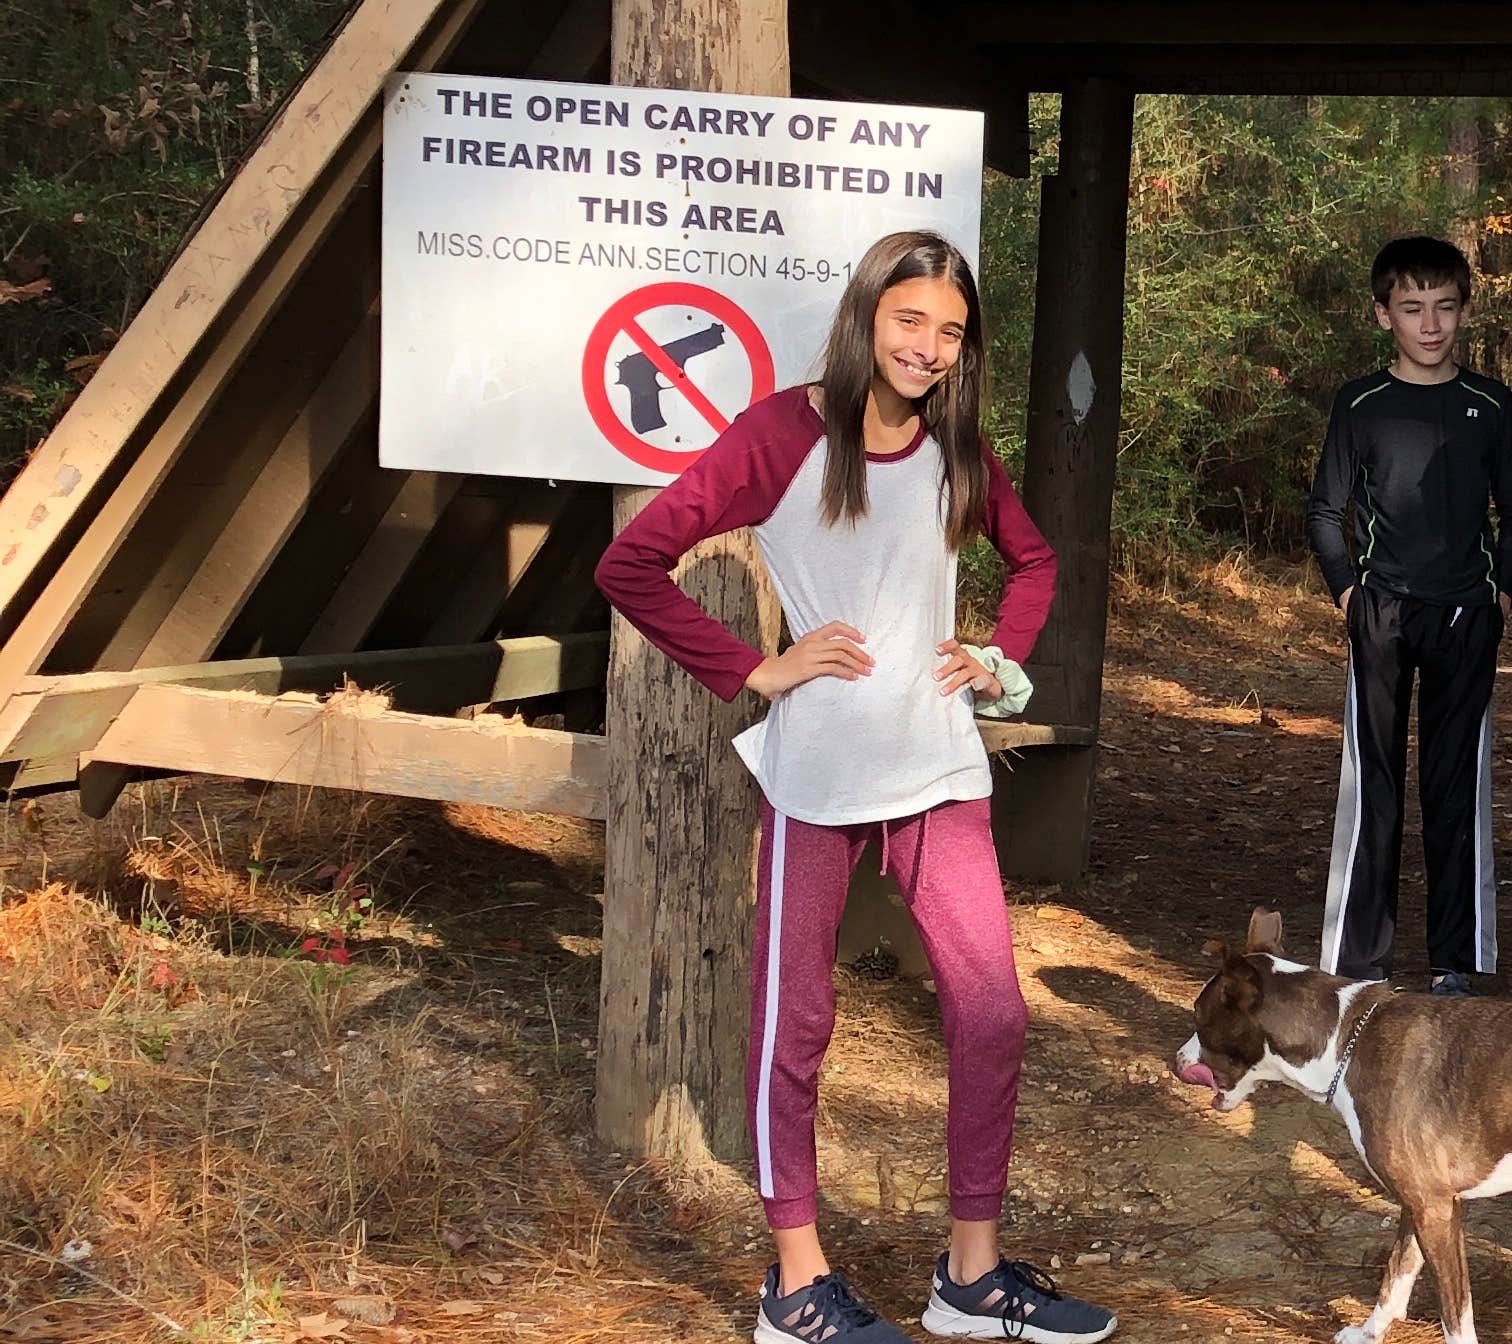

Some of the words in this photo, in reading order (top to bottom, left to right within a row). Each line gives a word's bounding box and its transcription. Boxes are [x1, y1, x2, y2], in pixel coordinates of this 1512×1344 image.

[436, 88, 513, 120] THE
[526, 95, 629, 128] OPEN
[644, 103, 775, 138] CARRY
[788, 114, 837, 142] OF
[850, 120, 931, 149] ANY
[422, 136, 591, 173] FIREARM
[607, 150, 641, 177] IS
[656, 153, 890, 195] PROHIBITED
[904, 171, 943, 199] IN
[579, 196, 668, 228] THIS
[681, 204, 785, 236] AREA
[417, 230, 571, 265] MISS.CODE
[578, 242, 767, 279] ANN.SECTION
